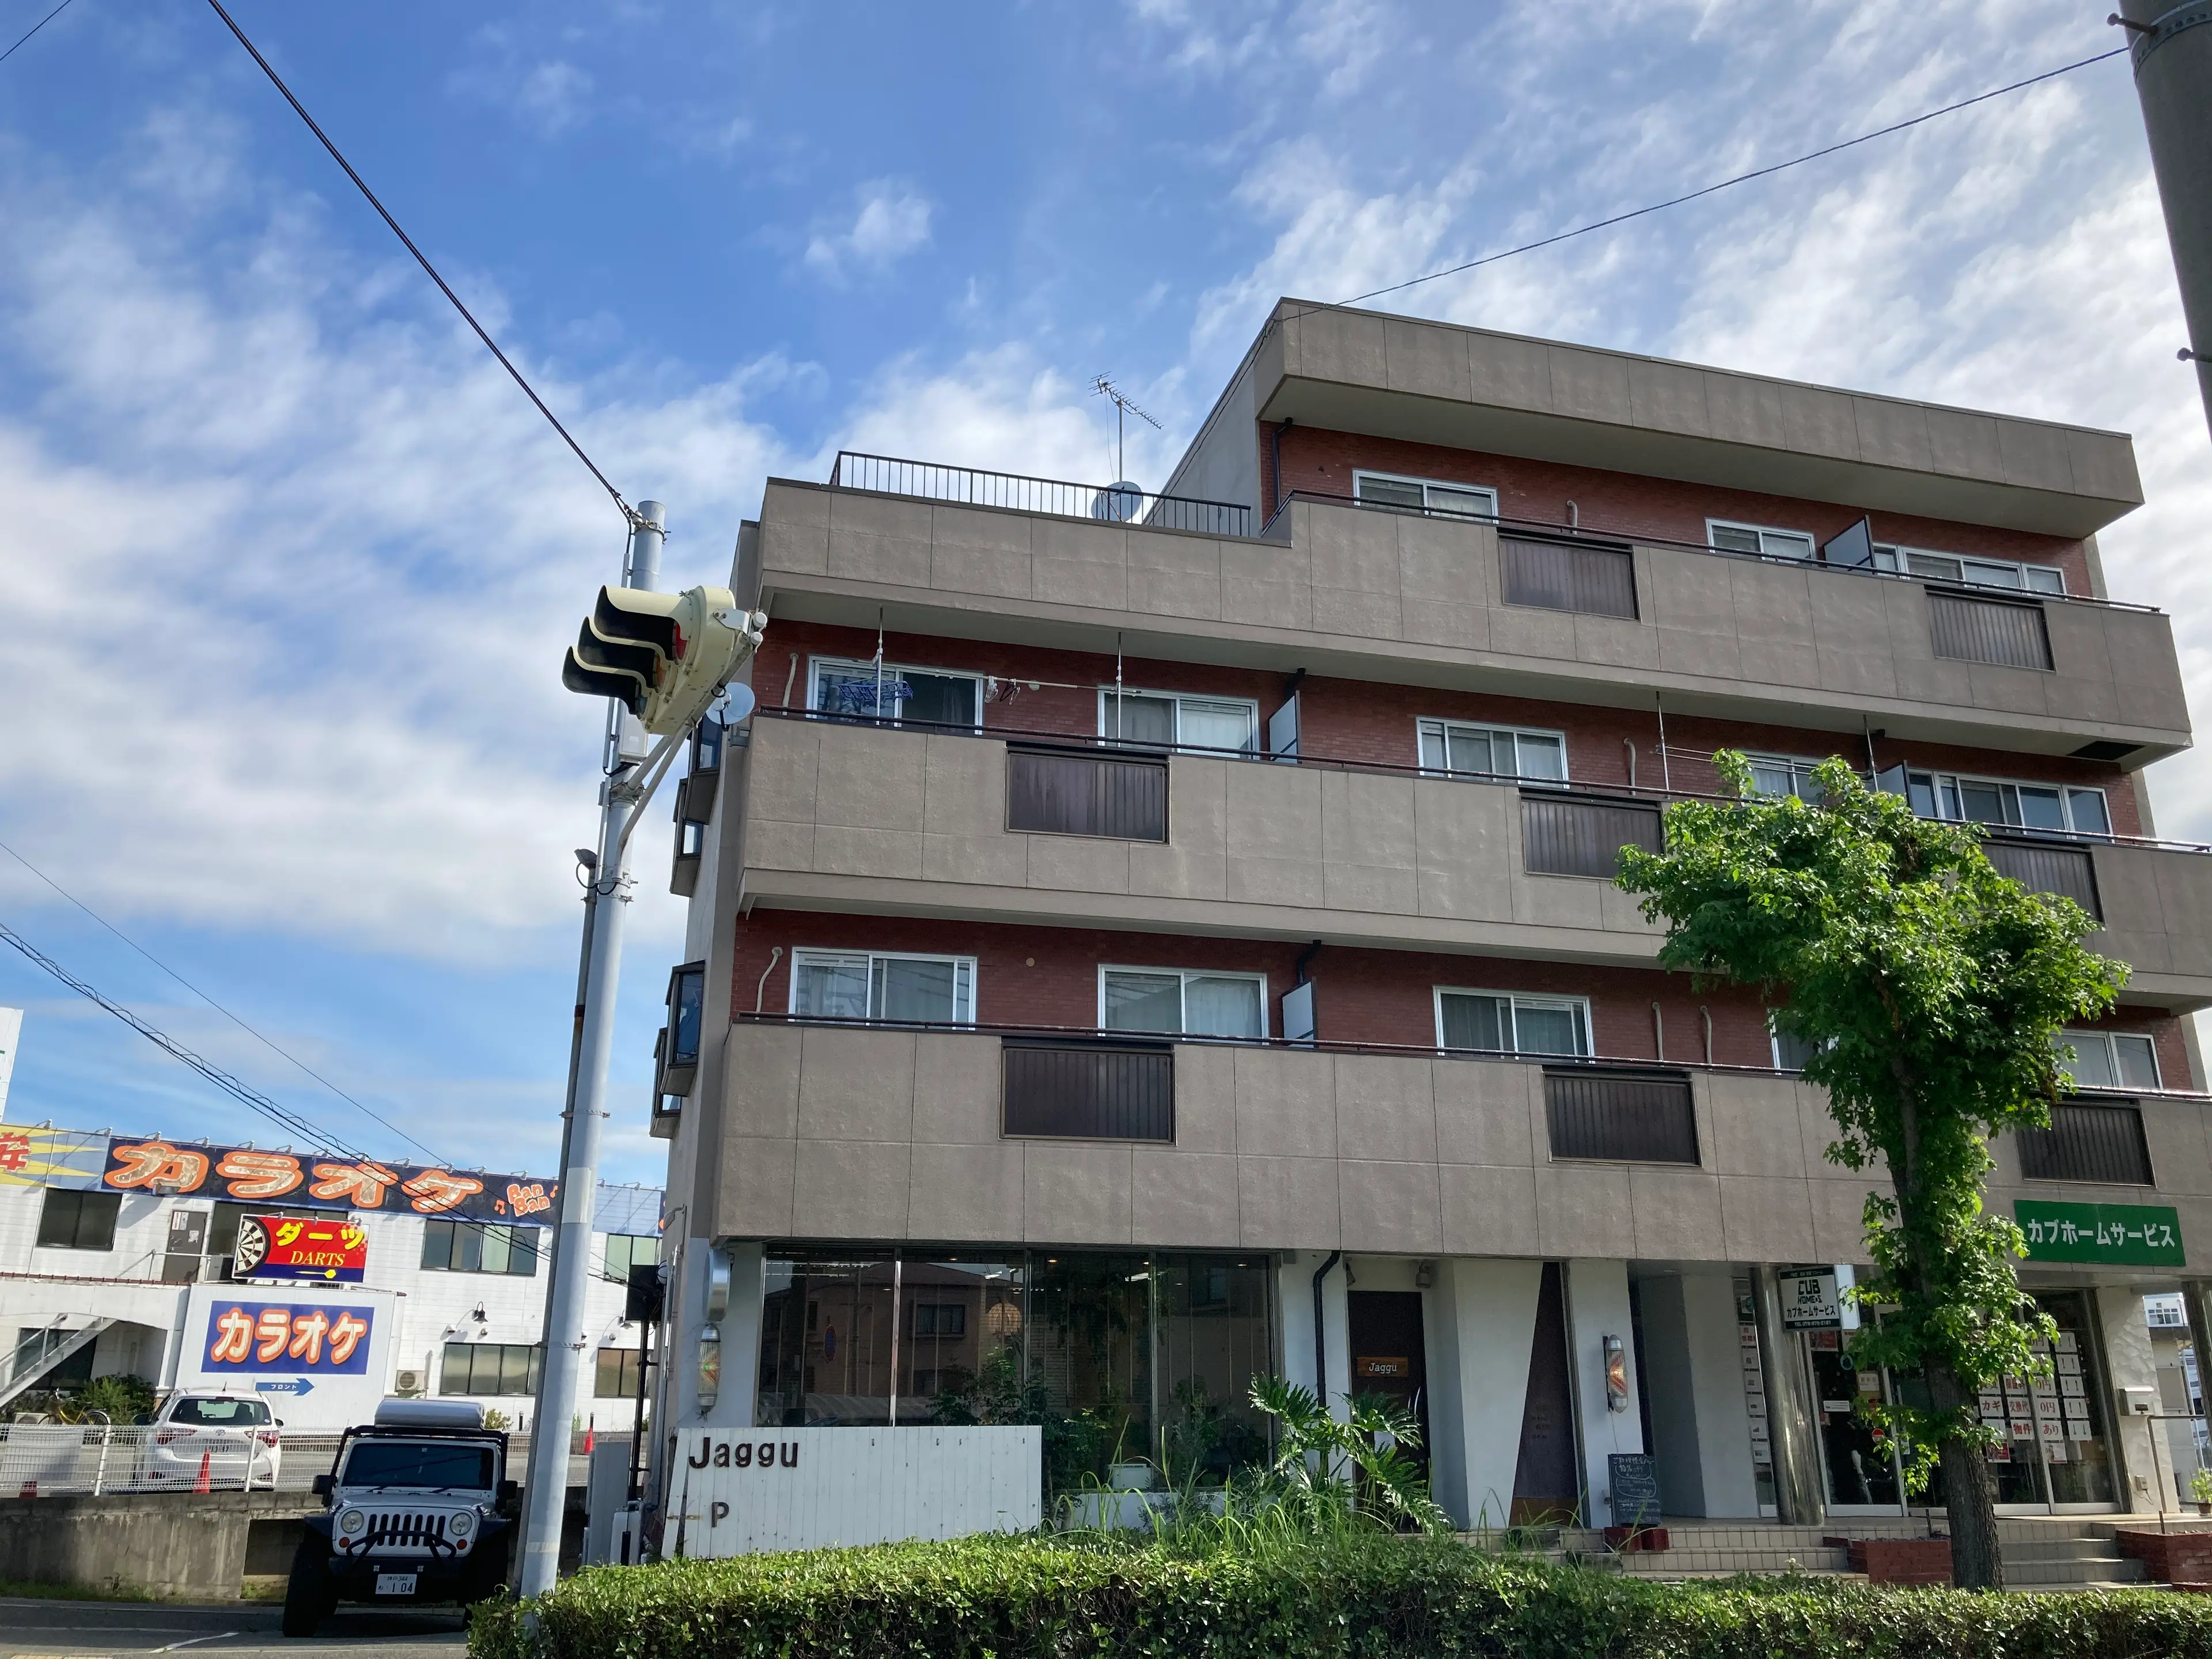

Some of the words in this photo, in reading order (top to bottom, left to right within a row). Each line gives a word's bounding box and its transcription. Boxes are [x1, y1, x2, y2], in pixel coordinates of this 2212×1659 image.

[104, 1142, 483, 1213] カラオケ
[507, 1184, 544, 1204] Ban
[514, 1196, 550, 1217] Ban
[276, 1222, 365, 1249] ダーツ
[2027, 1218, 2175, 1247] カブホームサービス
[290, 1251, 345, 1266] DARTS
[1798, 1279, 1821, 1295] CUB
[1787, 1305, 1836, 1317] カブホームサービス
[211, 1307, 367, 1364] カラオケ
[1369, 1363, 1397, 1374] Jaggu
[1982, 1400, 2001, 1412] カギ
[2009, 1400, 2030, 1413] 交換代
[2040, 1402, 2056, 1413] 0円
[2013, 1423, 2032, 1435] 物件
[2043, 1424, 2059, 1435] あり
[689, 1437, 798, 1468] Jaggu
[711, 1502, 729, 1528] P
